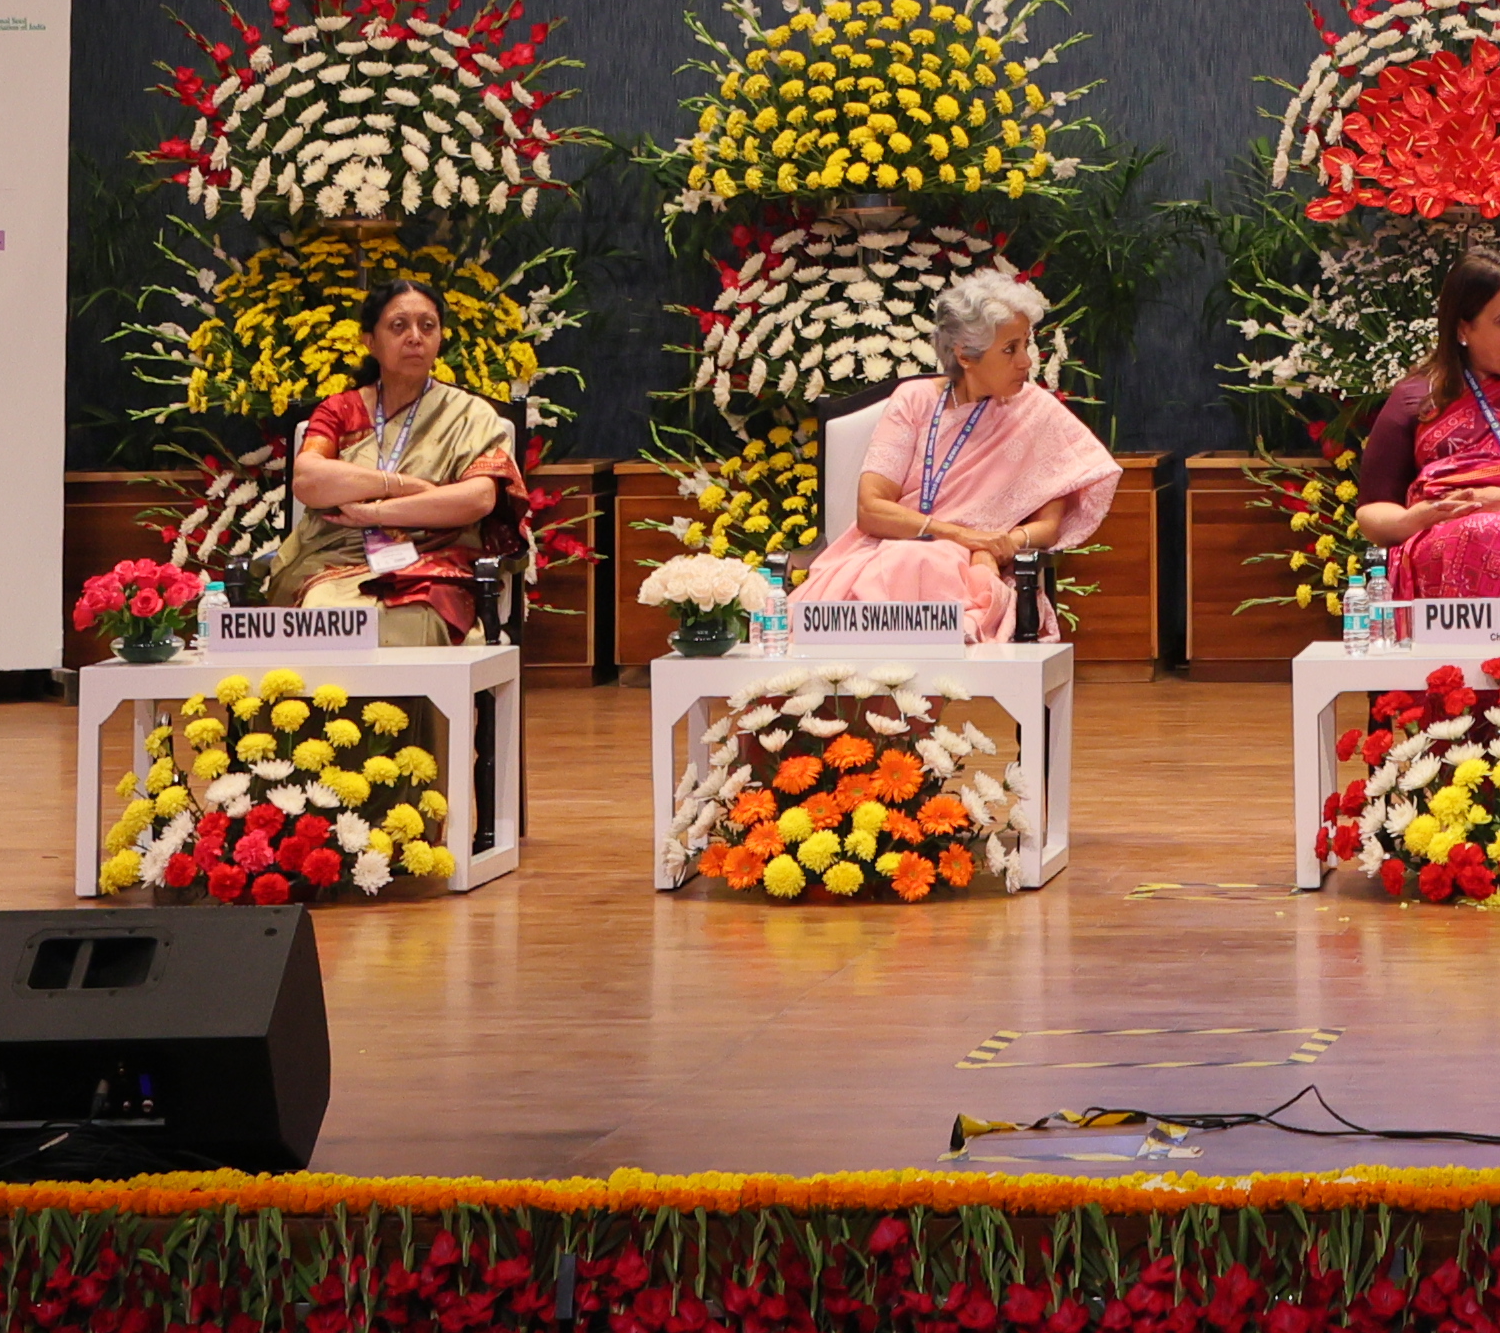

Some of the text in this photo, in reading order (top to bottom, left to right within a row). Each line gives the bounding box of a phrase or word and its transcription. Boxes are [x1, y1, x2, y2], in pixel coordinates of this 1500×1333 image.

[221, 609, 368, 639] RENU SWARUP
[803, 604, 957, 633] SOUMYA SWAMINATHAN
[1425, 603, 1492, 631] PURVI
